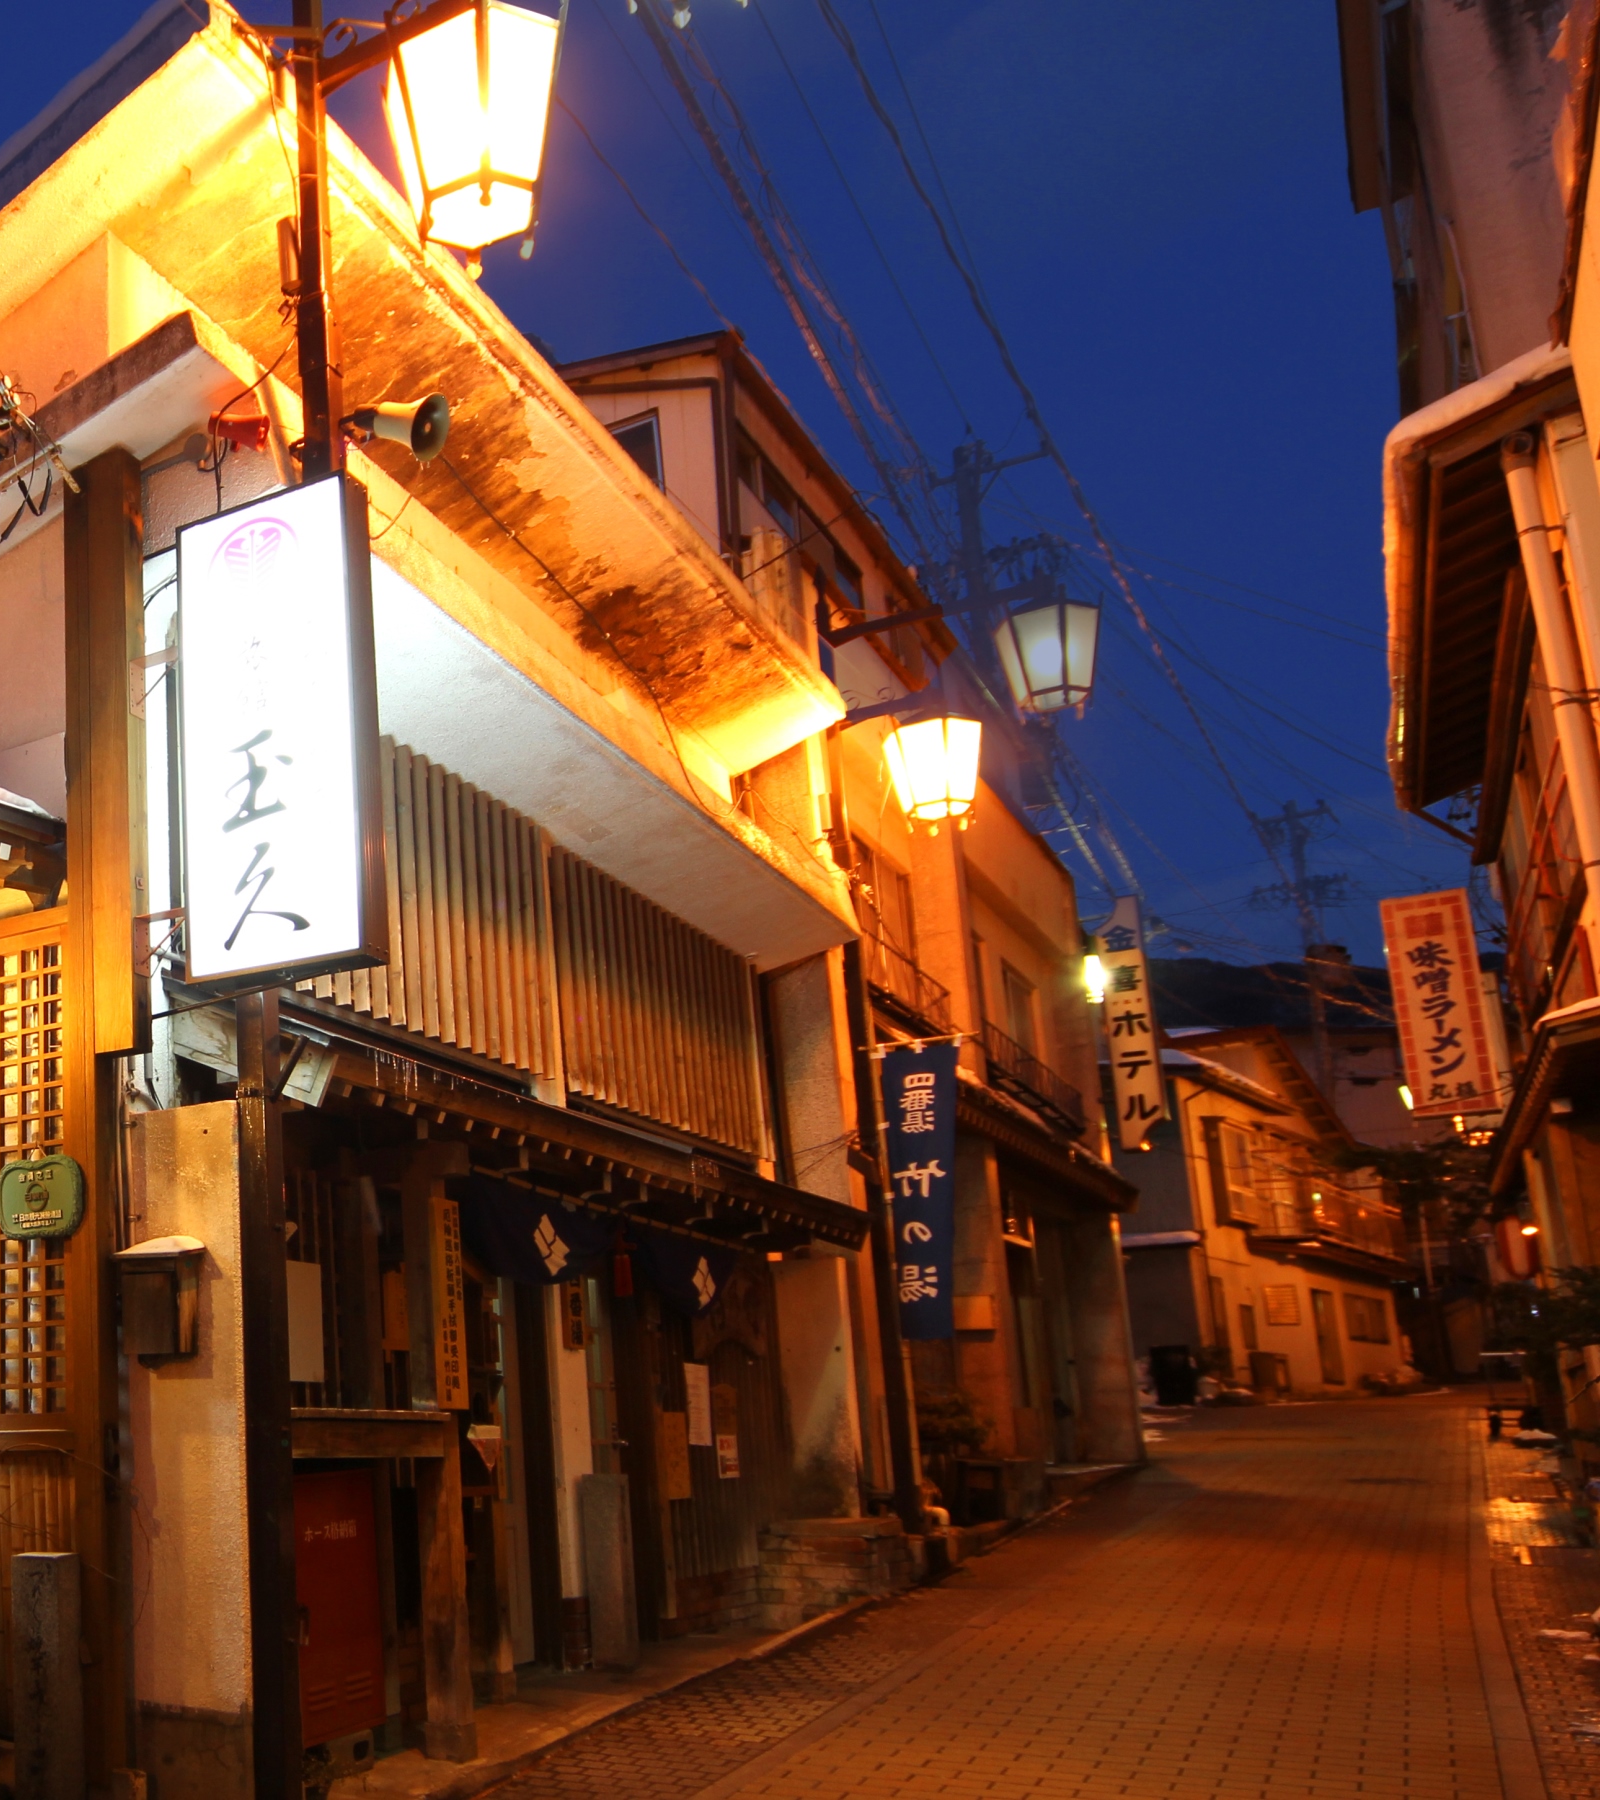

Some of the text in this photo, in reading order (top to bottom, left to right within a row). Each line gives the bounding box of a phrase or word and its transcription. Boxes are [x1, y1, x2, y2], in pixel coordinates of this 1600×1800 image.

[220, 728, 312, 953] 玉久
[1102, 924, 1160, 1122] 金喜ホテル
[1405, 940, 1467, 1079] 味噌ラーメン
